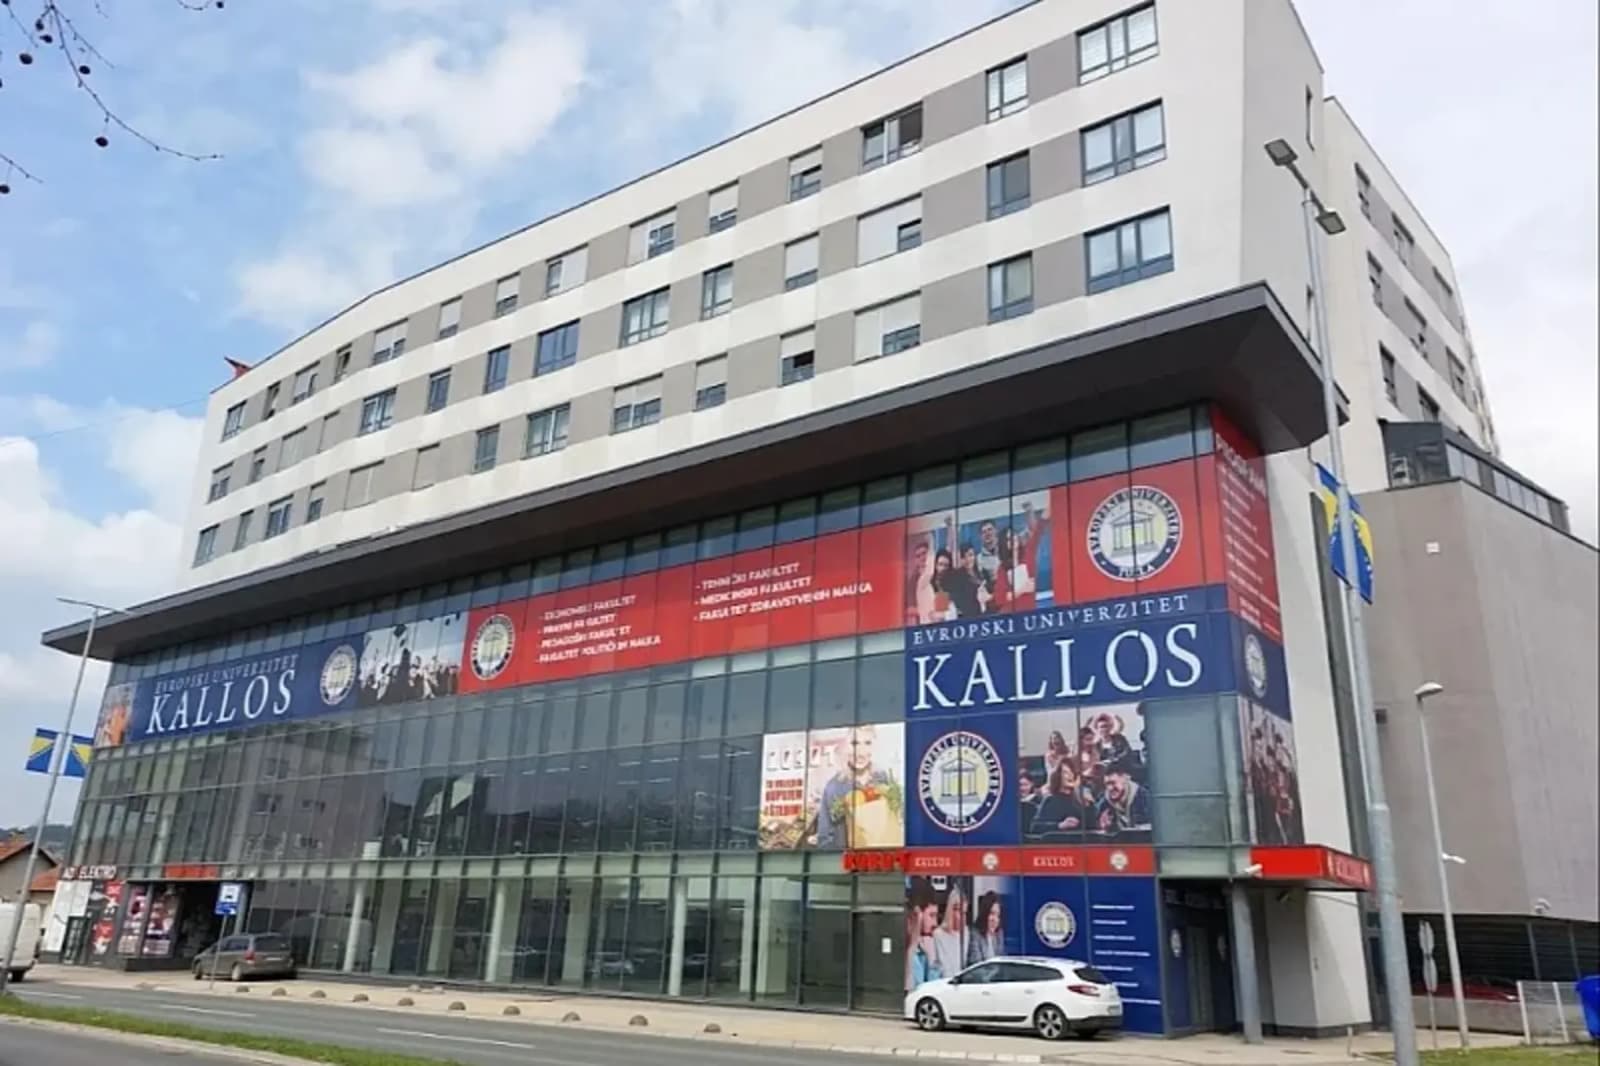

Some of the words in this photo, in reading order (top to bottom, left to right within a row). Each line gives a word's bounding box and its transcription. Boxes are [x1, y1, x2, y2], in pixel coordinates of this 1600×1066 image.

[749, 563, 801, 581] FAKULTET
[913, 619, 1015, 645] EVROPSKI
[1024, 594, 1189, 631] UNIVERZITET
[154, 672, 210, 694] EVROPSKI
[211, 654, 299, 684] UNIVERZITET
[912, 622, 1202, 711] KALLOS
[145, 669, 297, 735] KALLOS
